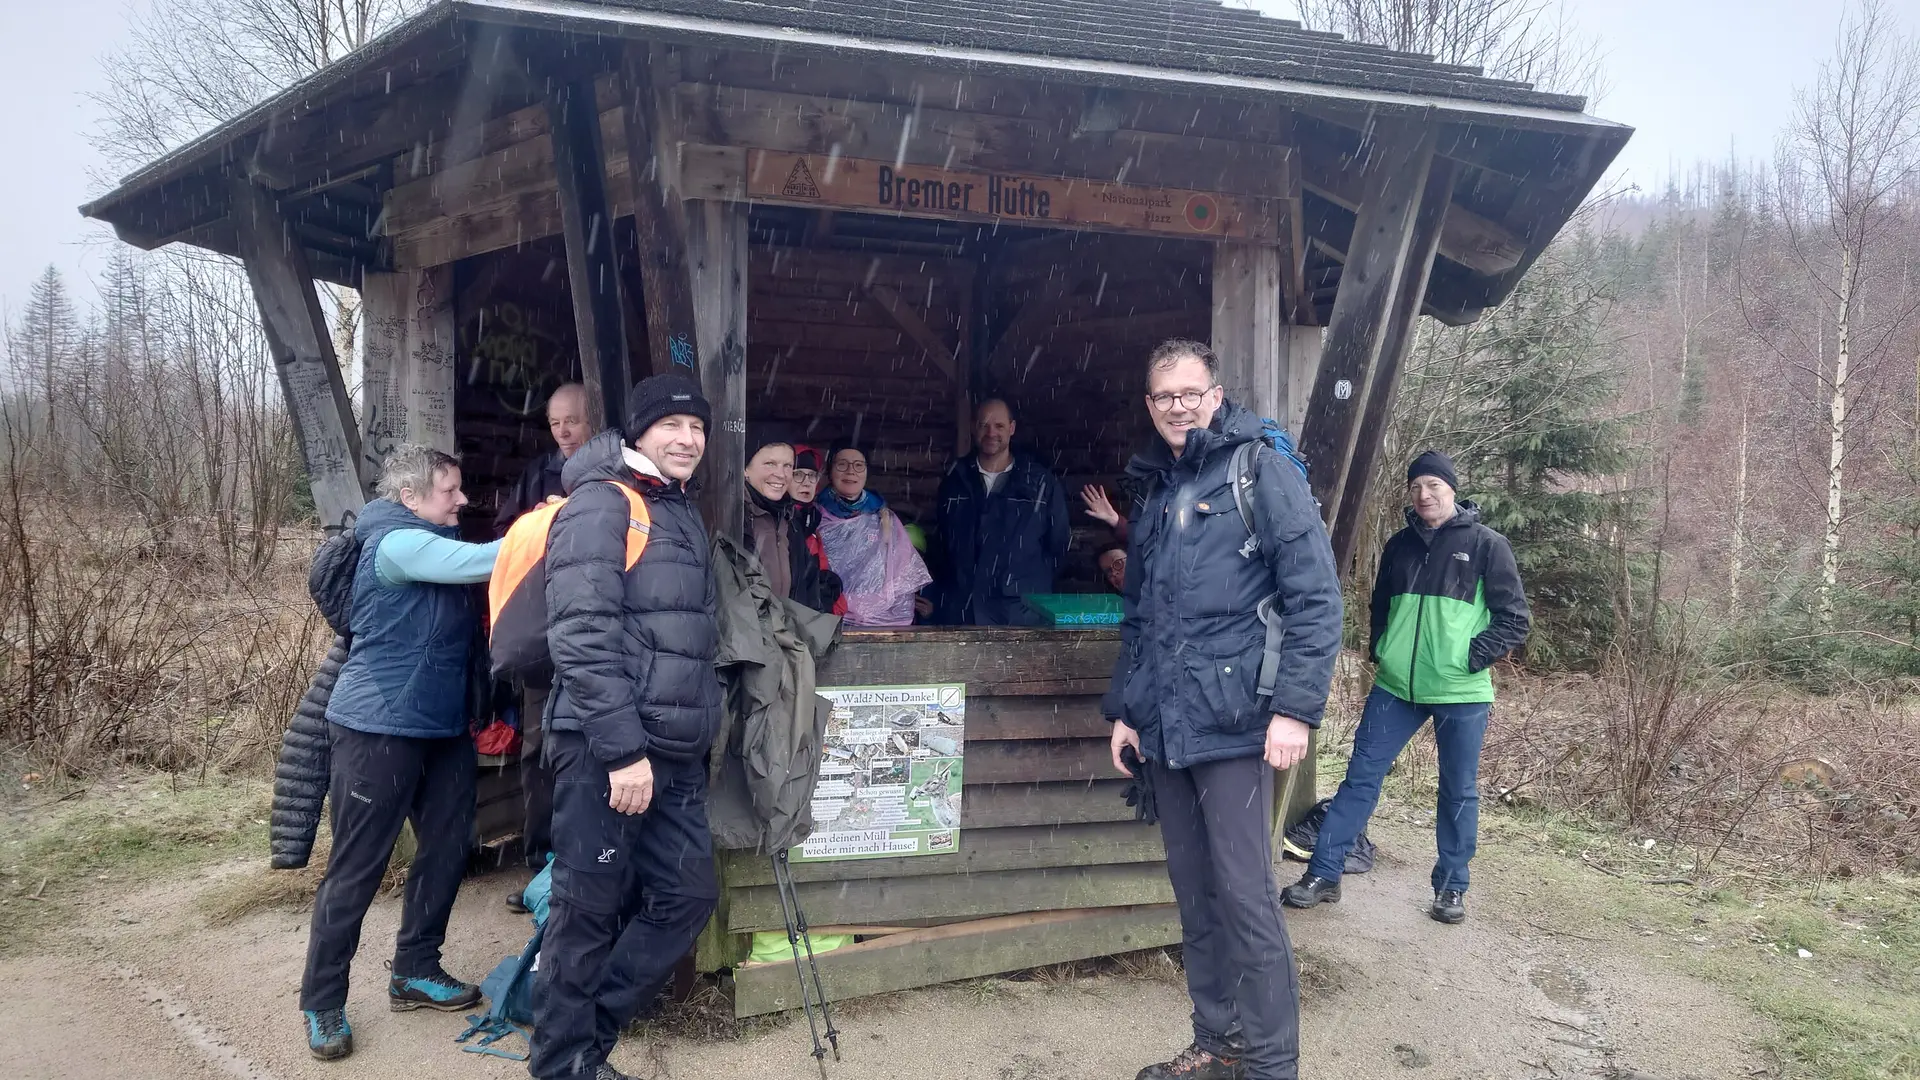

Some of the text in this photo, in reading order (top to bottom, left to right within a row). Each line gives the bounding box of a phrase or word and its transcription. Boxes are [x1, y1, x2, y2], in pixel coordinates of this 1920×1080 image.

[879, 165, 1051, 218] Bremer Hütte
[1102, 192, 1172, 209] Nationalpark
[1144, 210, 1172, 224] Harz
[842, 693, 872, 704] Wald?
[875, 692, 898, 703] Nein
[901, 691, 935, 702] Danke!
[829, 833, 861, 844] deinen
[863, 830, 886, 841] Müll
[805, 840, 916, 855] wieder mit nach Hause!
